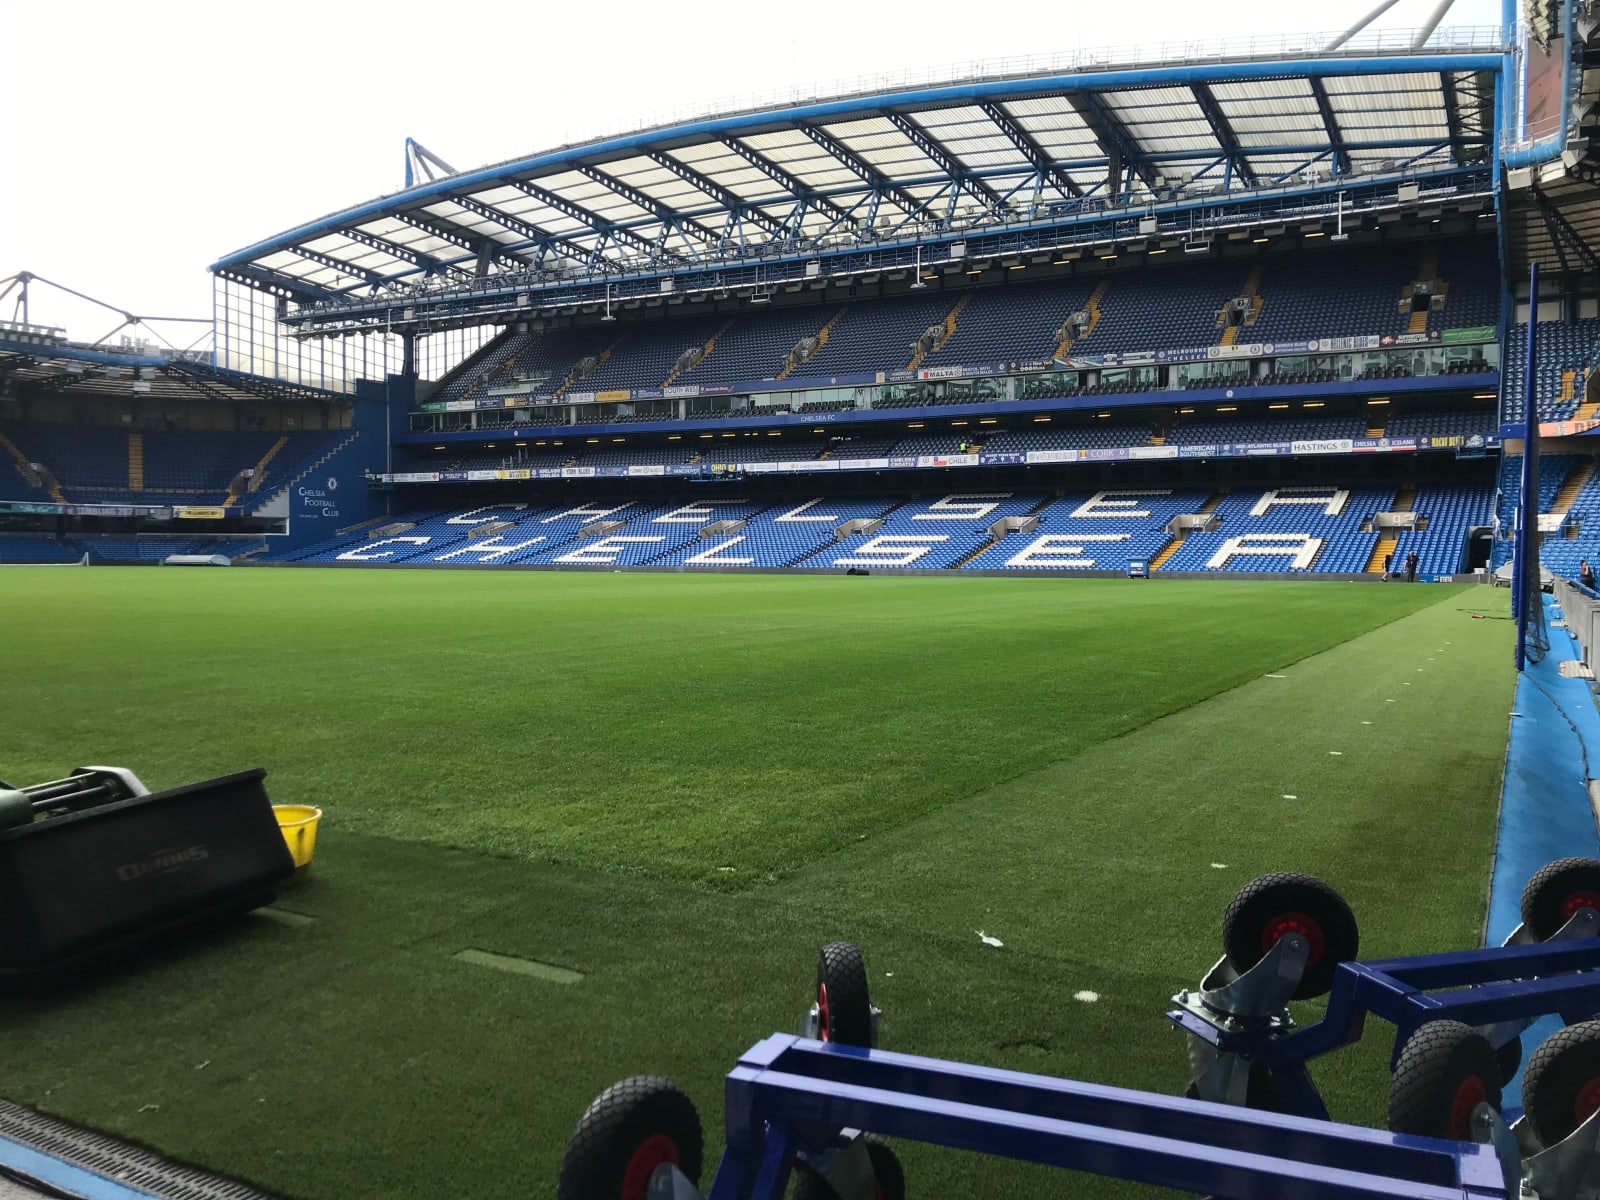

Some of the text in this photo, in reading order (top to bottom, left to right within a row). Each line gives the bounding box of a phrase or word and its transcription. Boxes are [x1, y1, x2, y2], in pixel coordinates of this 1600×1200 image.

[929, 370, 954, 378] MALTA
[1180, 444, 1216, 452] AMERICAN
[1294, 442, 1338, 451] HASTINGS
[1091, 449, 1114, 458] CORK
[948, 456, 968, 465] CHILE
[711, 463, 726, 473] OHIO
[298, 486, 326, 497] CHELSEA
[304, 496, 337, 508] FOOTBALL
[446, 486, 1350, 525] CHELSEA
[322, 507, 340, 517] CLUB
[336, 533, 1323, 568] CHELSEA
[115, 843, 209, 881] DENNIS
